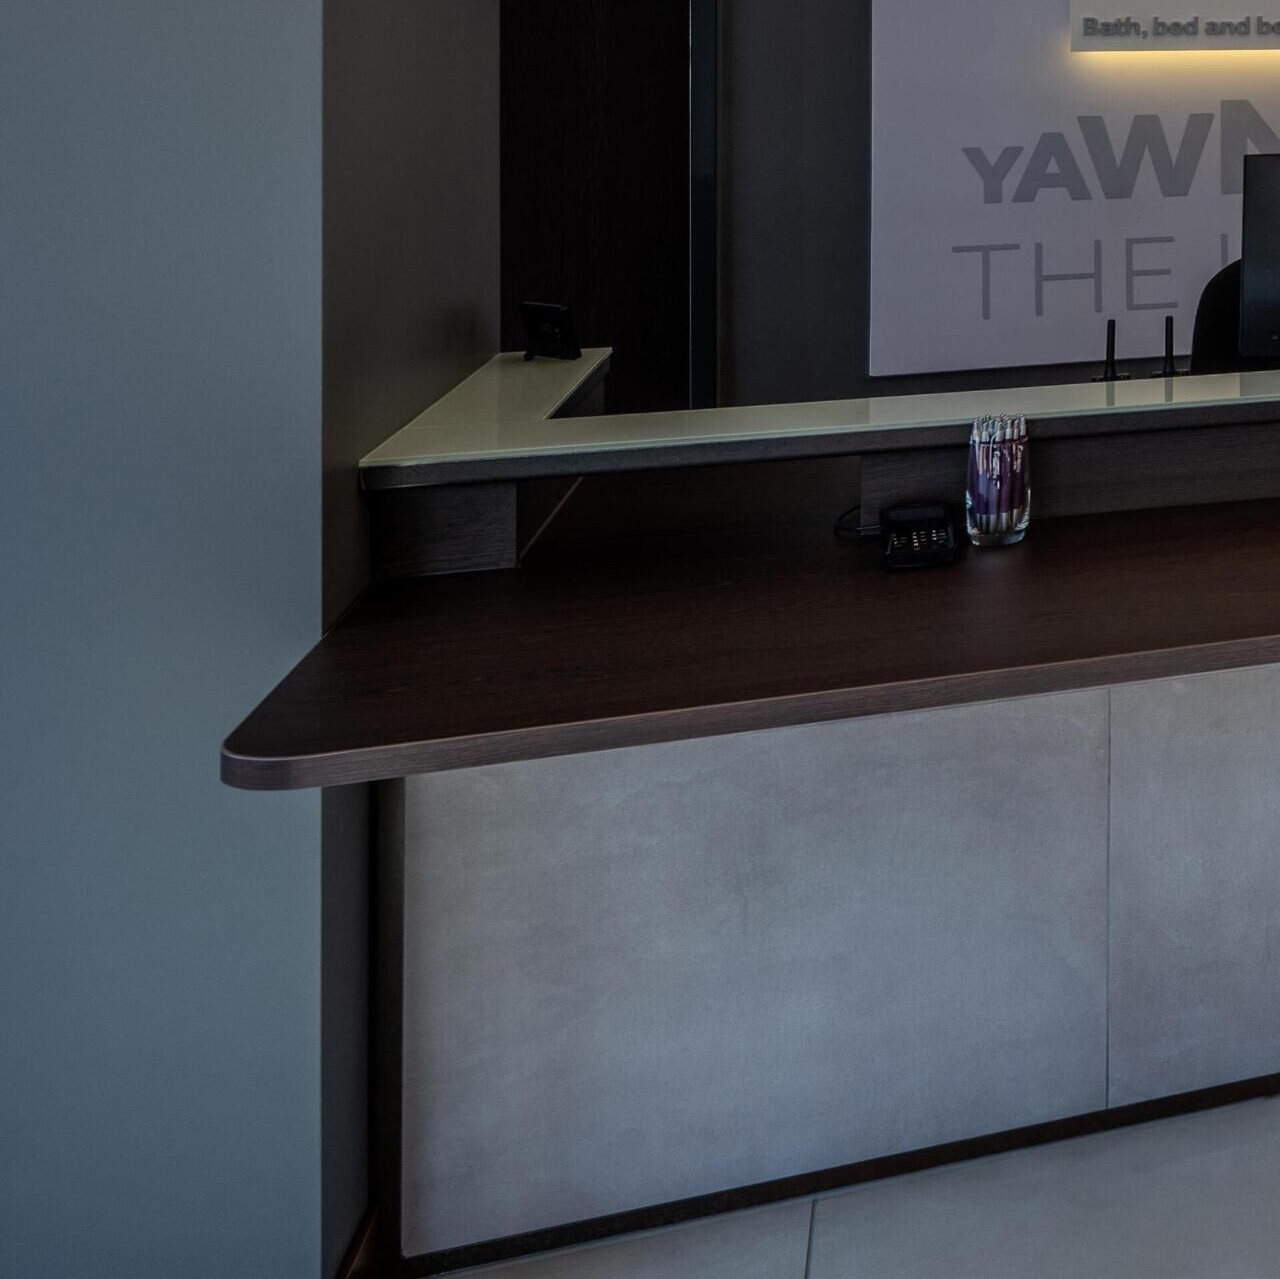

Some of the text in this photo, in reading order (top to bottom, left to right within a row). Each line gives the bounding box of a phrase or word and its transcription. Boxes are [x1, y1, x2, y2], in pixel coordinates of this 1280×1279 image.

[1082, 16, 1149, 40] Bath,
[1152, 16, 1200, 37] bed
[1204, 15, 1251, 37] and
[951, 235, 1178, 322] THE
